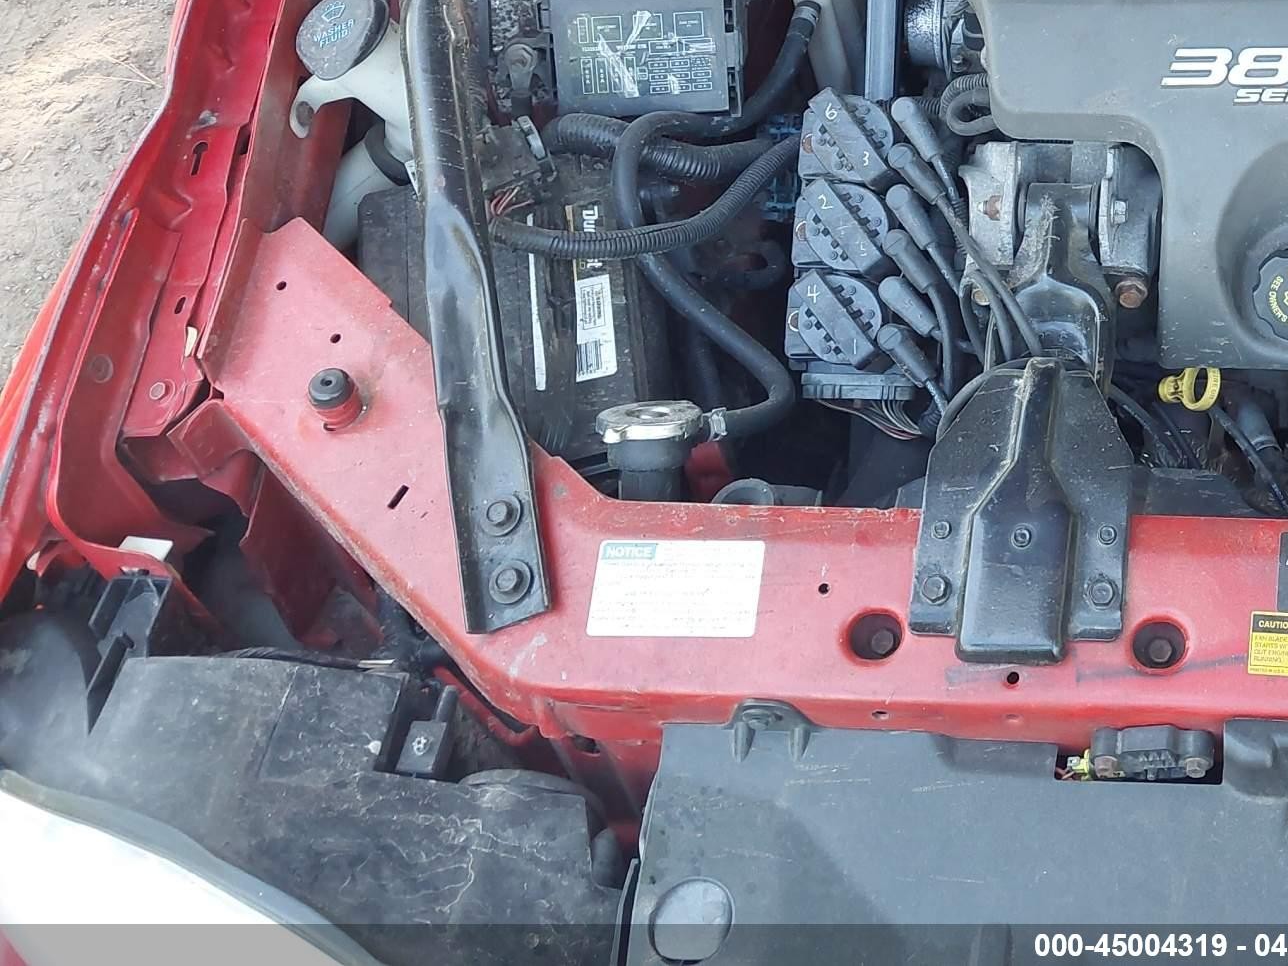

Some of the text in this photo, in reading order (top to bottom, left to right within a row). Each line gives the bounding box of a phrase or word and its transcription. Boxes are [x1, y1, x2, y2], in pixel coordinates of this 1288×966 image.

[313, 18, 354, 43] WASHER
[319, 28, 350, 48] FLUID
[824, 103, 838, 121] 6
[862, 151, 870, 167] 3
[818, 194, 834, 211] 2
[582, 205, 603, 270] Durst
[1270, 275, 1284, 291] SEE
[806, 284, 820, 304] 4
[607, 545, 653, 559] NOTICE
